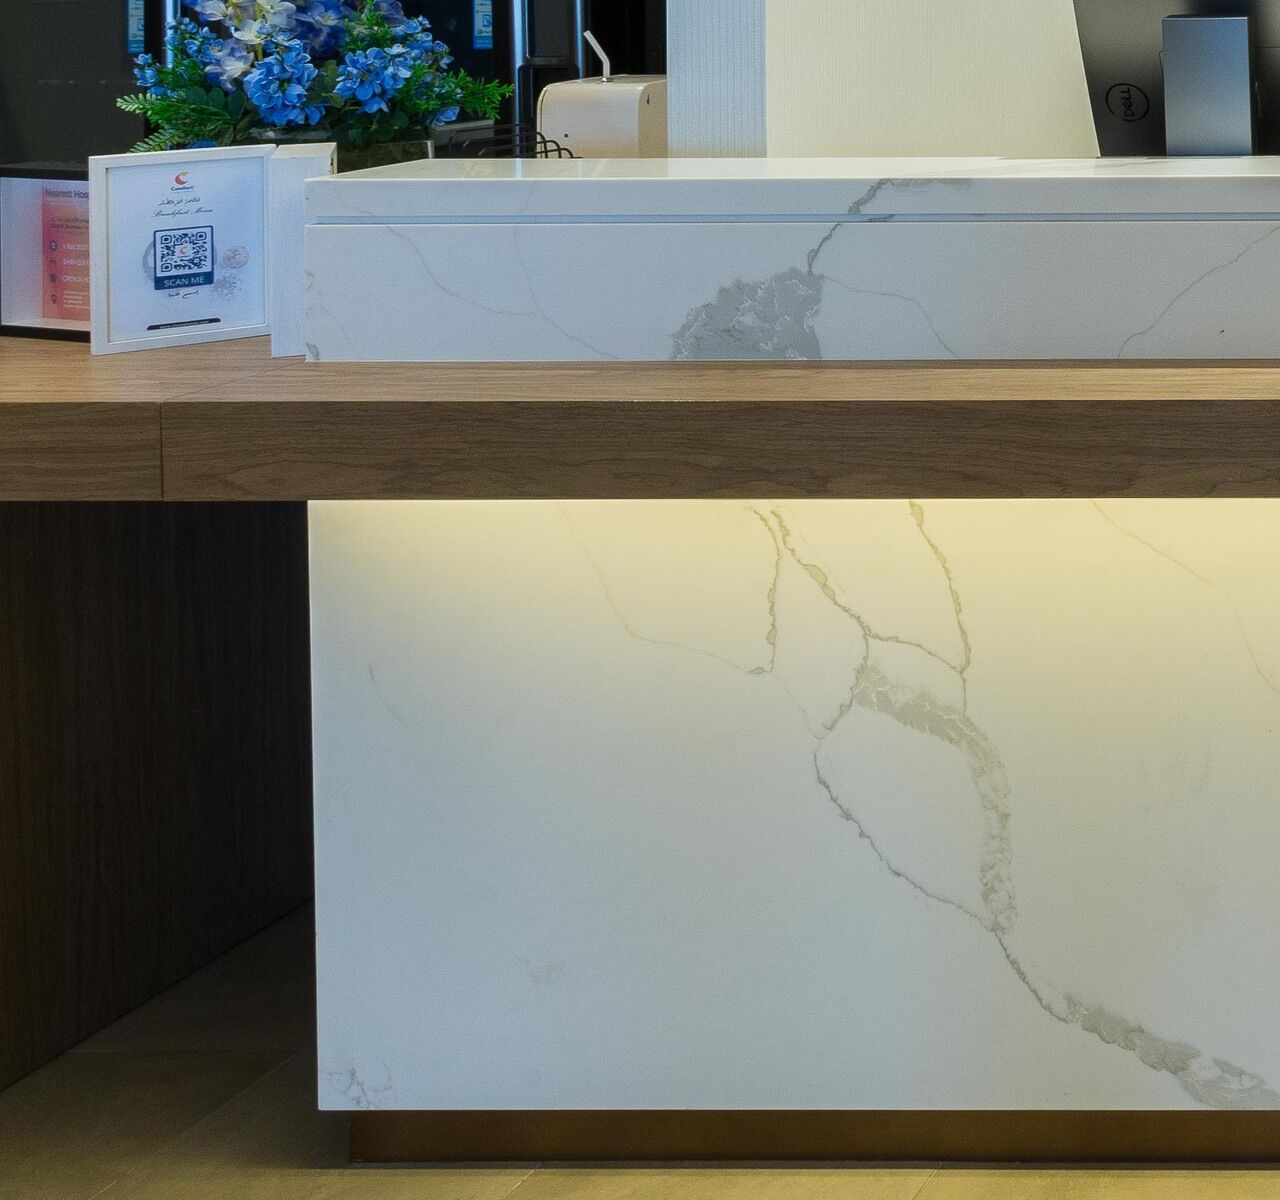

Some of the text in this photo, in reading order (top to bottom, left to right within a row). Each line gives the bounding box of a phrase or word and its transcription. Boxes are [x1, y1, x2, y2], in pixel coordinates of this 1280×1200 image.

[1119, 87, 1135, 117] DELL
[164, 275, 205, 287] SCAN ME
